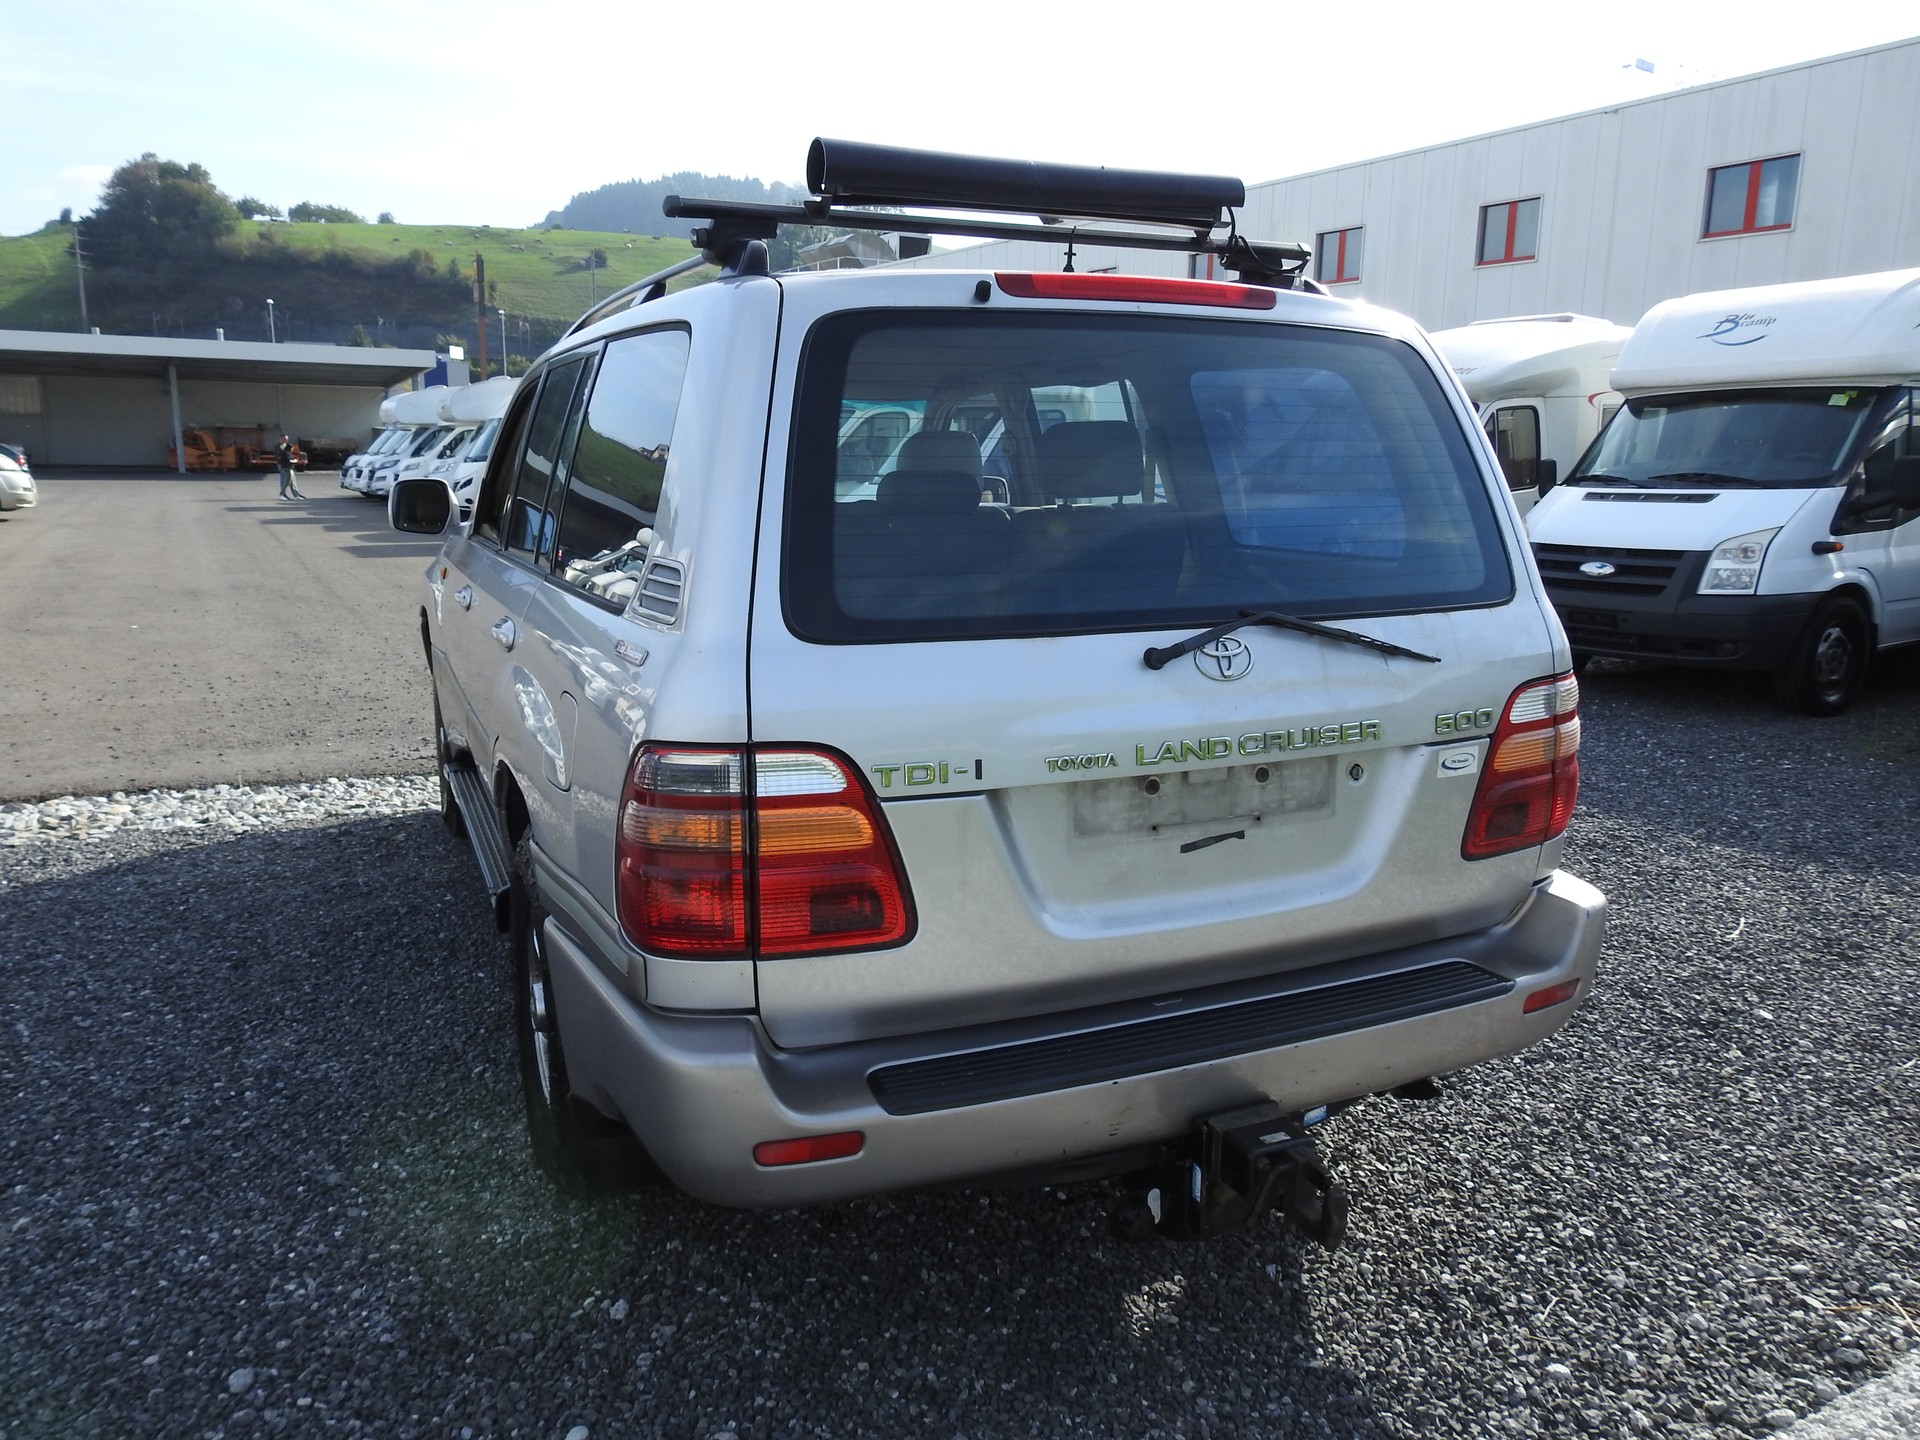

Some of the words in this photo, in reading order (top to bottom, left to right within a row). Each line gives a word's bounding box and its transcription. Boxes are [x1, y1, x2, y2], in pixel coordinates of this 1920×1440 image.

[1740, 317, 1777, 328] camp
[1434, 707, 1493, 735] 500
[1045, 752, 1118, 772] TOYOTA
[1136, 736, 1233, 766] LAND
[1238, 719, 1381, 756] CRUISER
